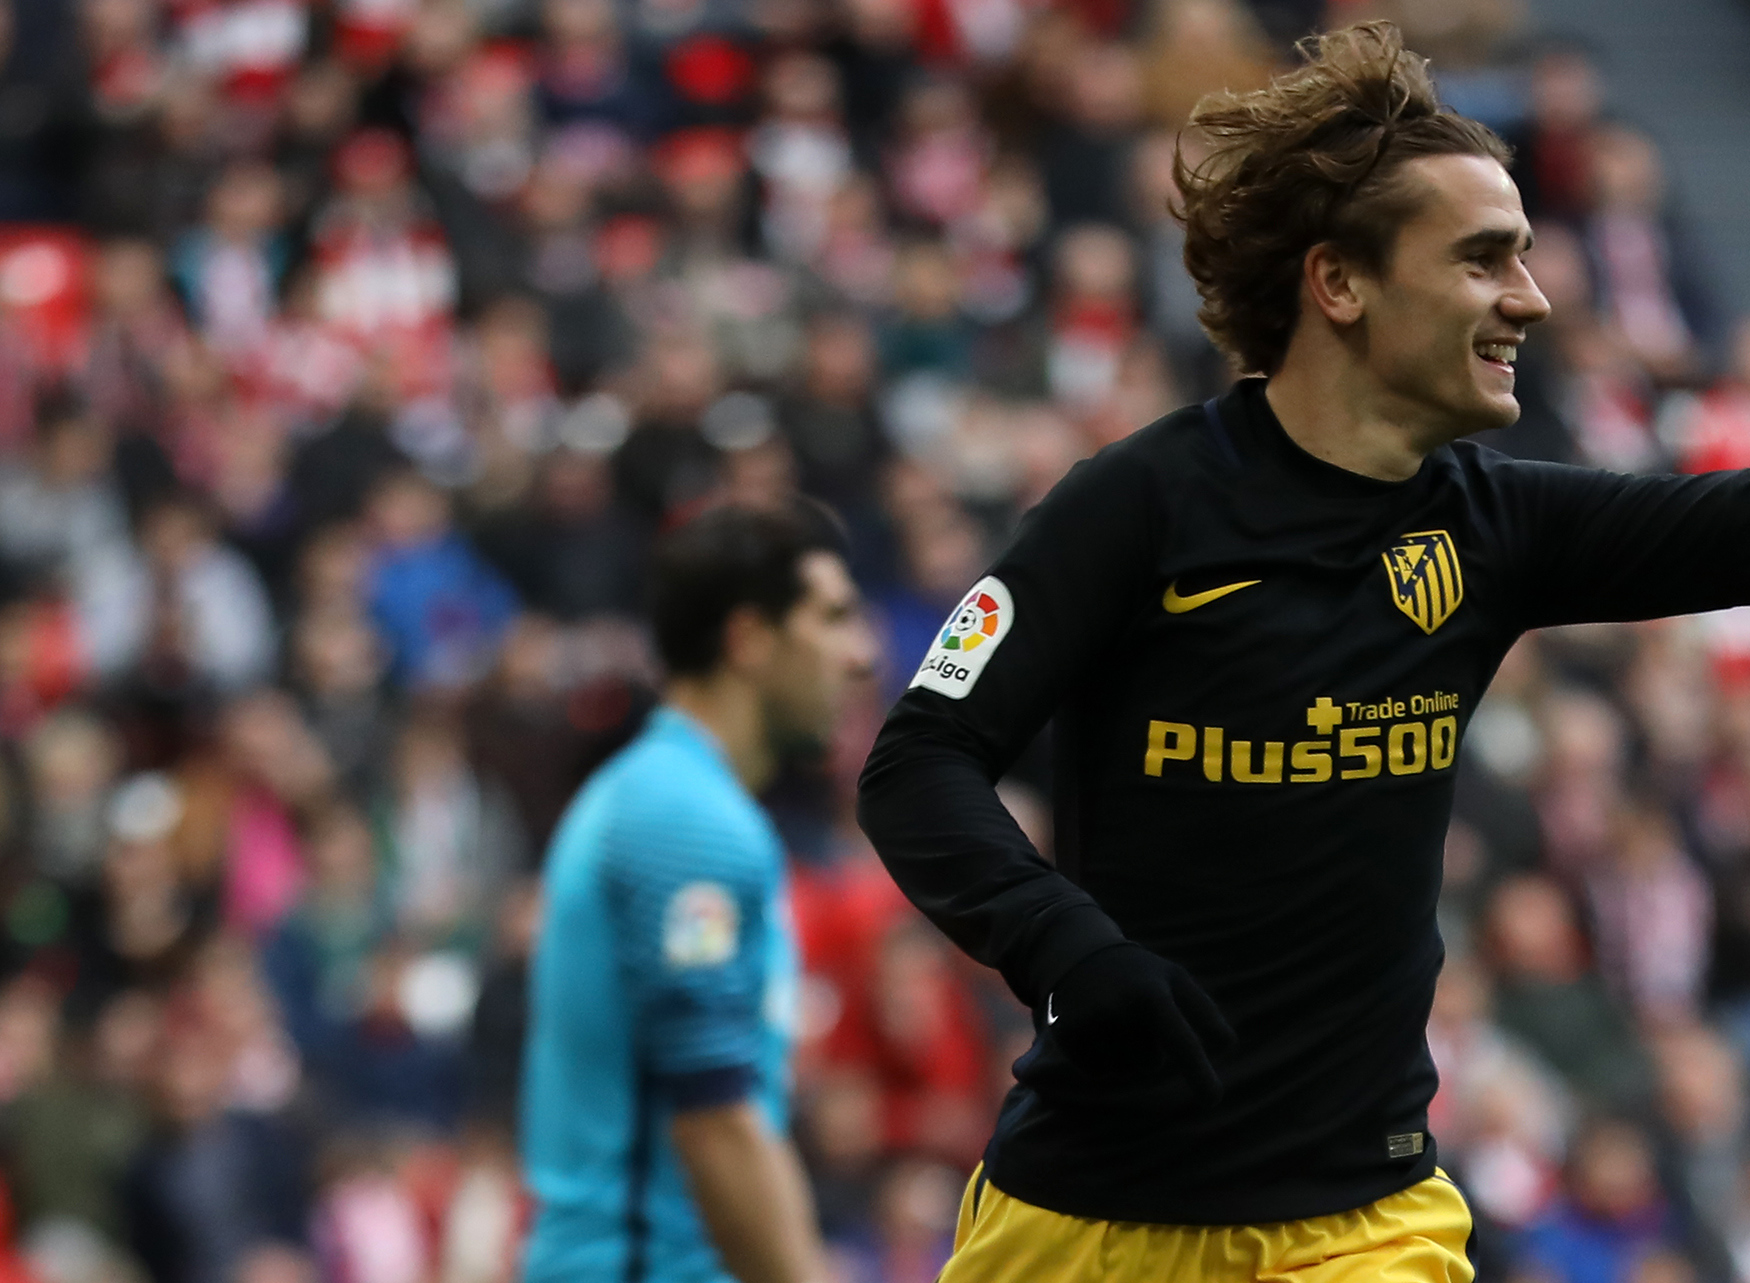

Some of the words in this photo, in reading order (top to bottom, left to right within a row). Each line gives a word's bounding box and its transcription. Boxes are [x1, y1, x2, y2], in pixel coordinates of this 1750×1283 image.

[1346, 697, 1406, 722] Trade
[1411, 690, 1459, 716] Online
[1144, 714, 1458, 784] Plus500
